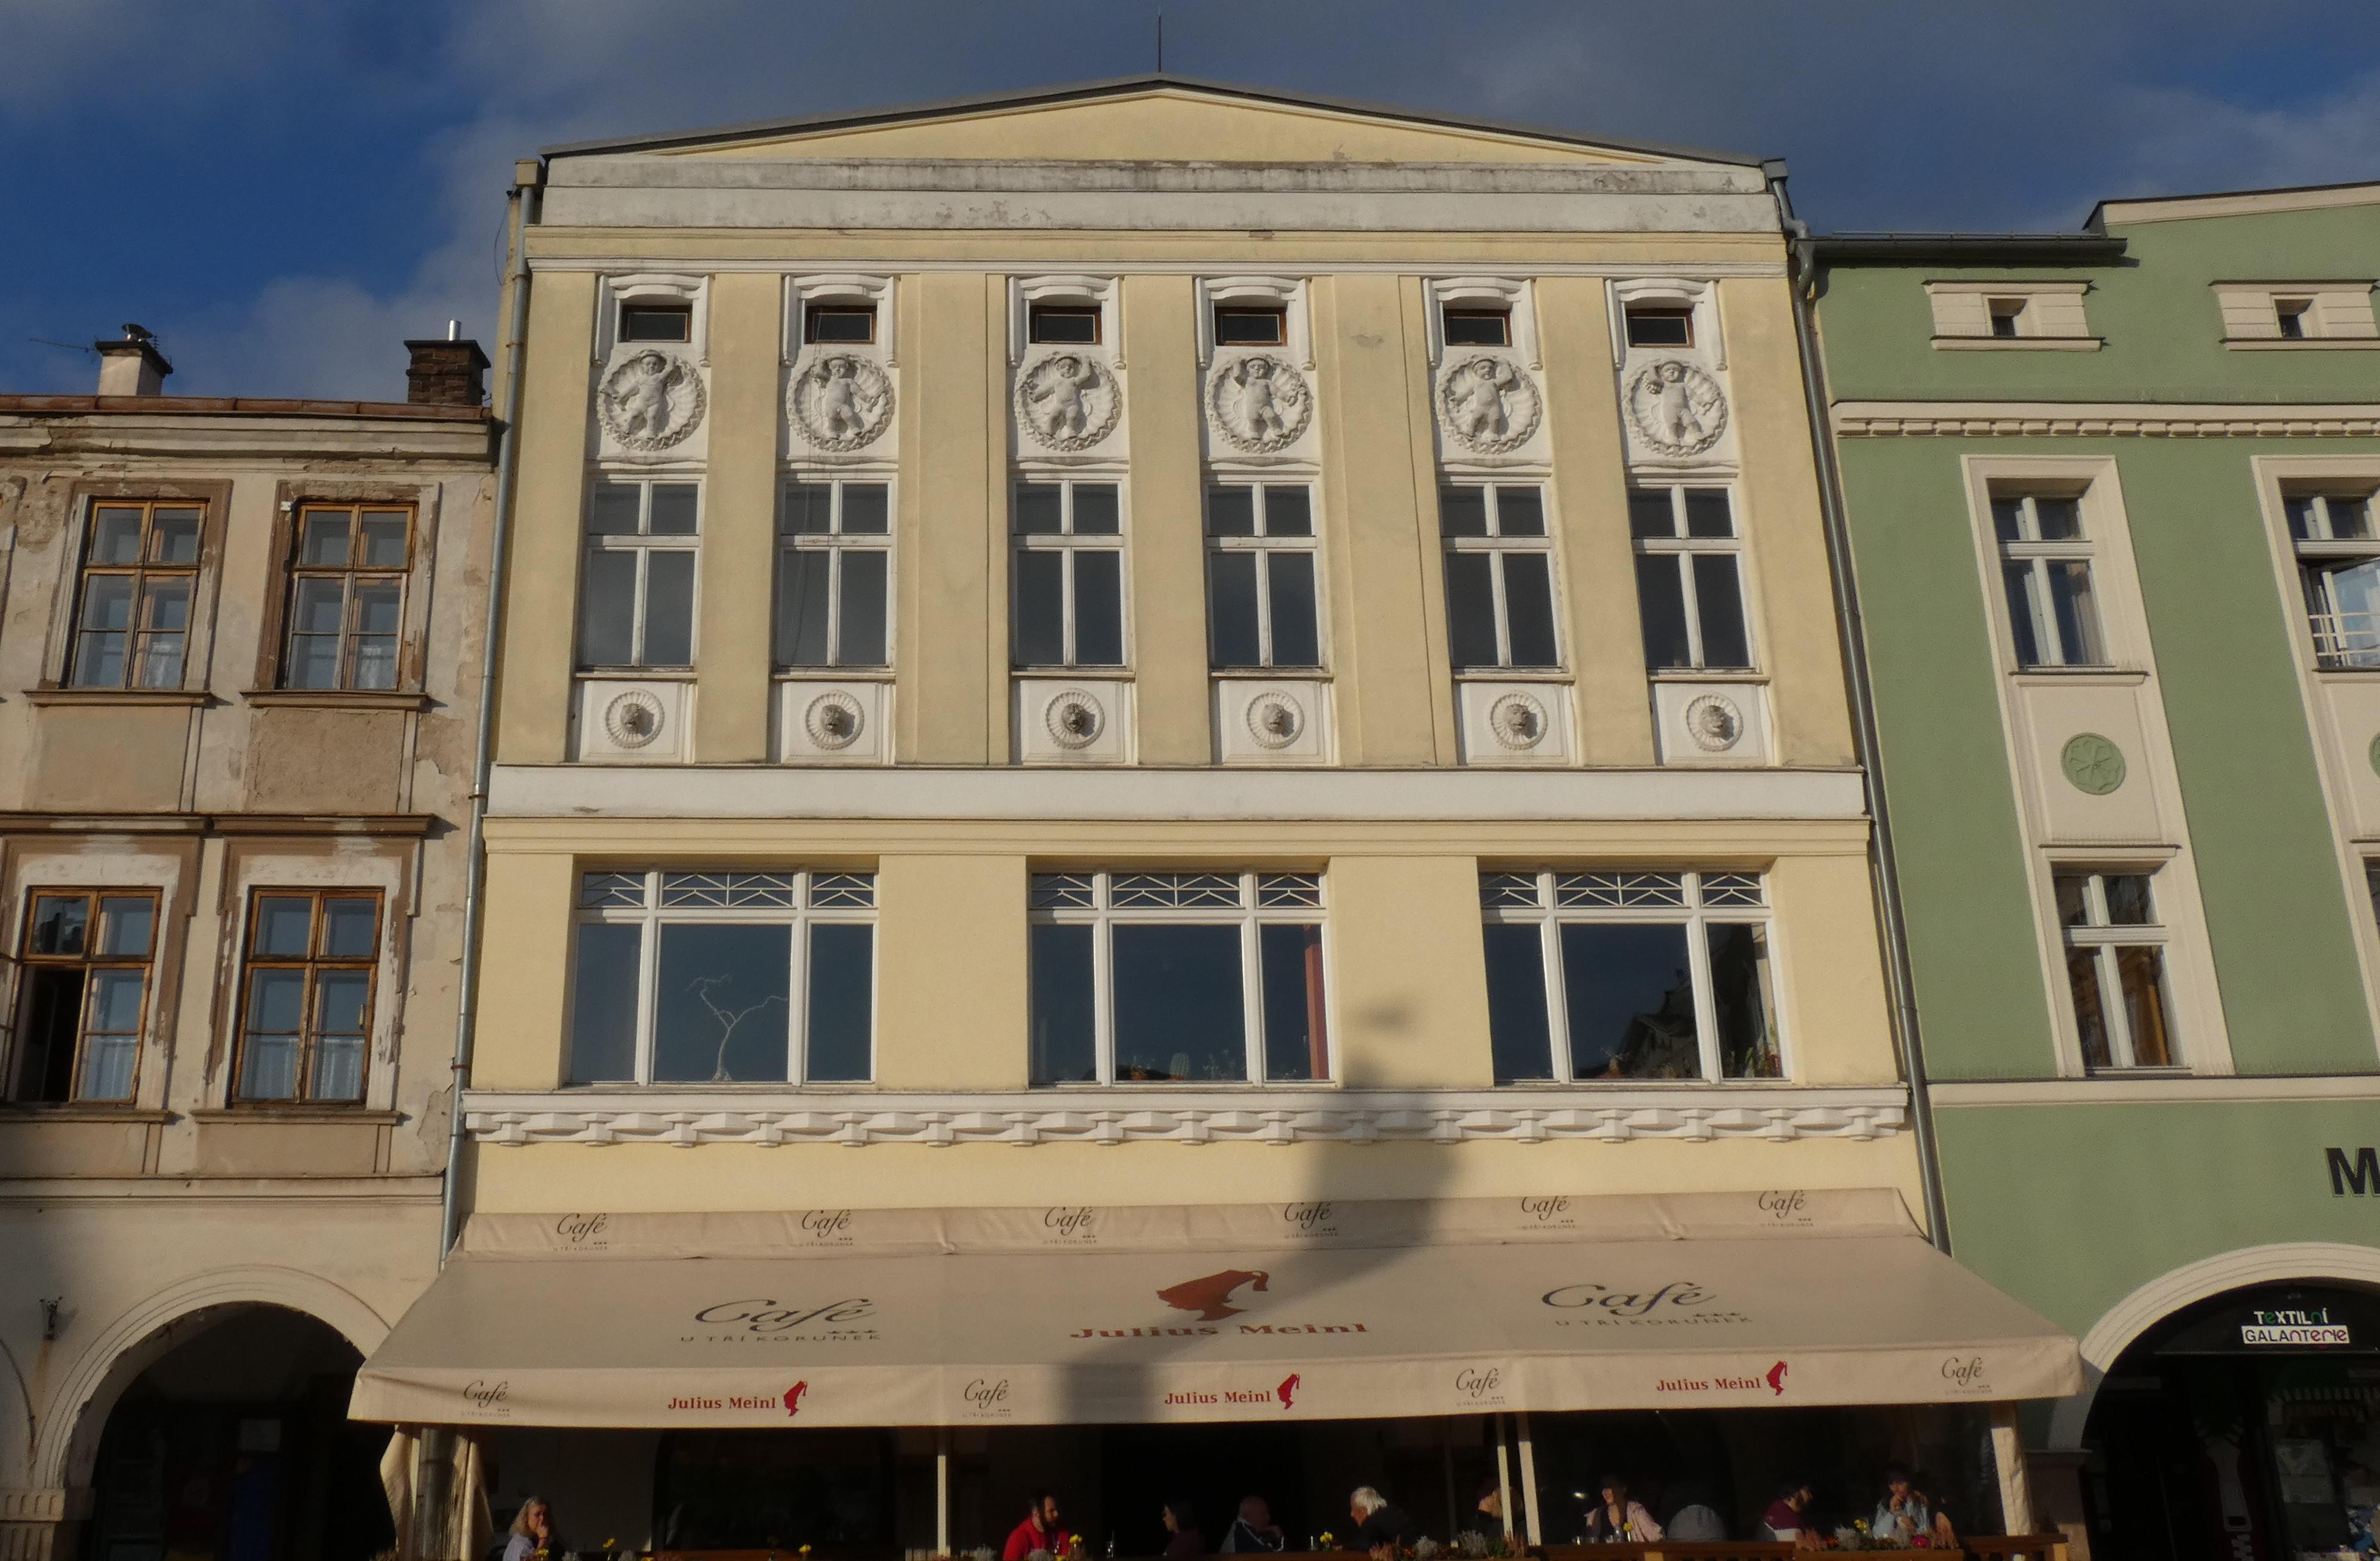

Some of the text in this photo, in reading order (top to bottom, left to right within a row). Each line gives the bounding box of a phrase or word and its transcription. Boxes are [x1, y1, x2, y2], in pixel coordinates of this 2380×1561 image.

[557, 1212, 608, 1242] Café
[802, 1209, 851, 1237] Café
[1542, 1282, 1717, 1316] Café
[695, 1298, 876, 1332] Café
[1071, 1323, 1369, 1338] Julius Meinl
[1457, 1368, 1500, 1398] Café
[1657, 1377, 1761, 1391] Julius Meinl
[1942, 1356, 1985, 1386] Café
[464, 1380, 508, 1409] Café
[668, 1396, 776, 1409] Julius Meinl
[965, 1379, 1009, 1409] Café
[1165, 1391, 1271, 1405] Julius Meinl
